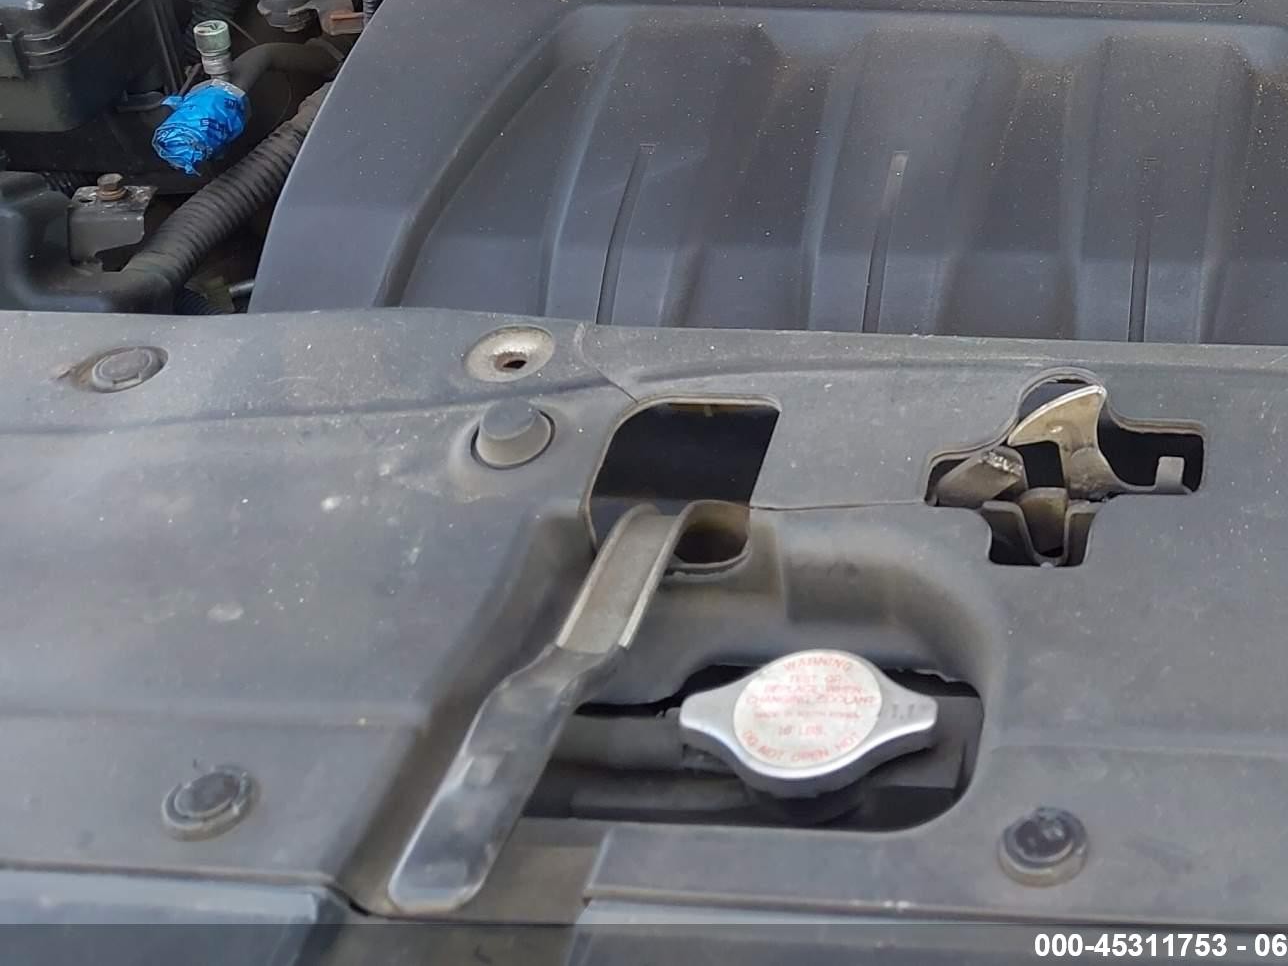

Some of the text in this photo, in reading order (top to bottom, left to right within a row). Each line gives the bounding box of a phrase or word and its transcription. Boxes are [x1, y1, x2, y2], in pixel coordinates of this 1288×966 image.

[783, 657, 853, 673] WARNING
[790, 674, 841, 683] TEST OR
[743, 729, 859, 762] DO NOT OPEN HOT
